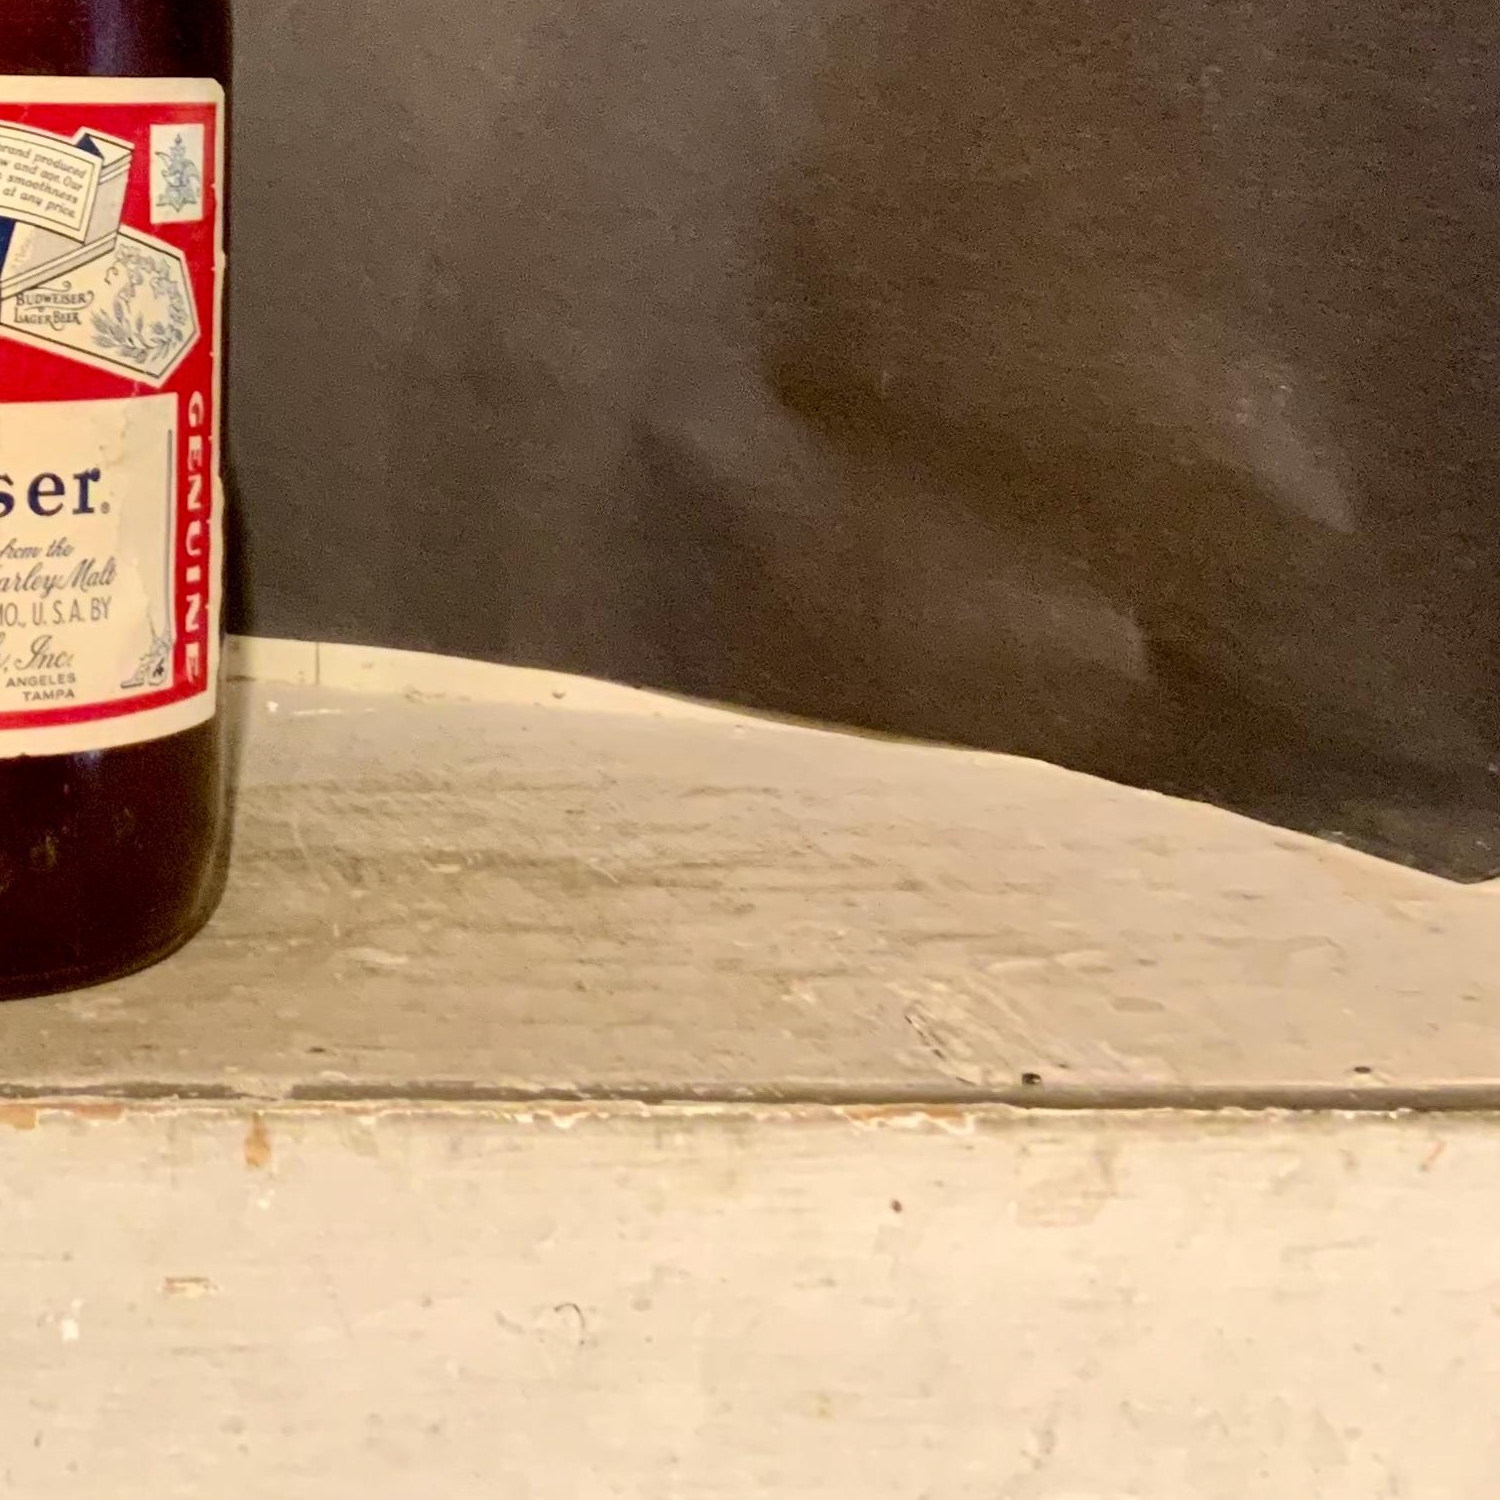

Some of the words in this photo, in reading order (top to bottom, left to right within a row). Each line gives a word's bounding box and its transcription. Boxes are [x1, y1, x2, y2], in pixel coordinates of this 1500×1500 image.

[13, 158, 38, 175] and
[62, 174, 84, 191] Our
[34, 152, 87, 179] produced
[3, 186, 17, 197] at
[20, 191, 43, 207] any
[7, 174, 79, 205] smoothness
[45, 536, 75, 558] the
[184, 390, 205, 684] GENUINE
[61, 556, 117, 593] Malt
[90, 596, 113, 621] BY
[5, 672, 77, 688] ANGELES
[22, 688, 76, 702] TAMPA
